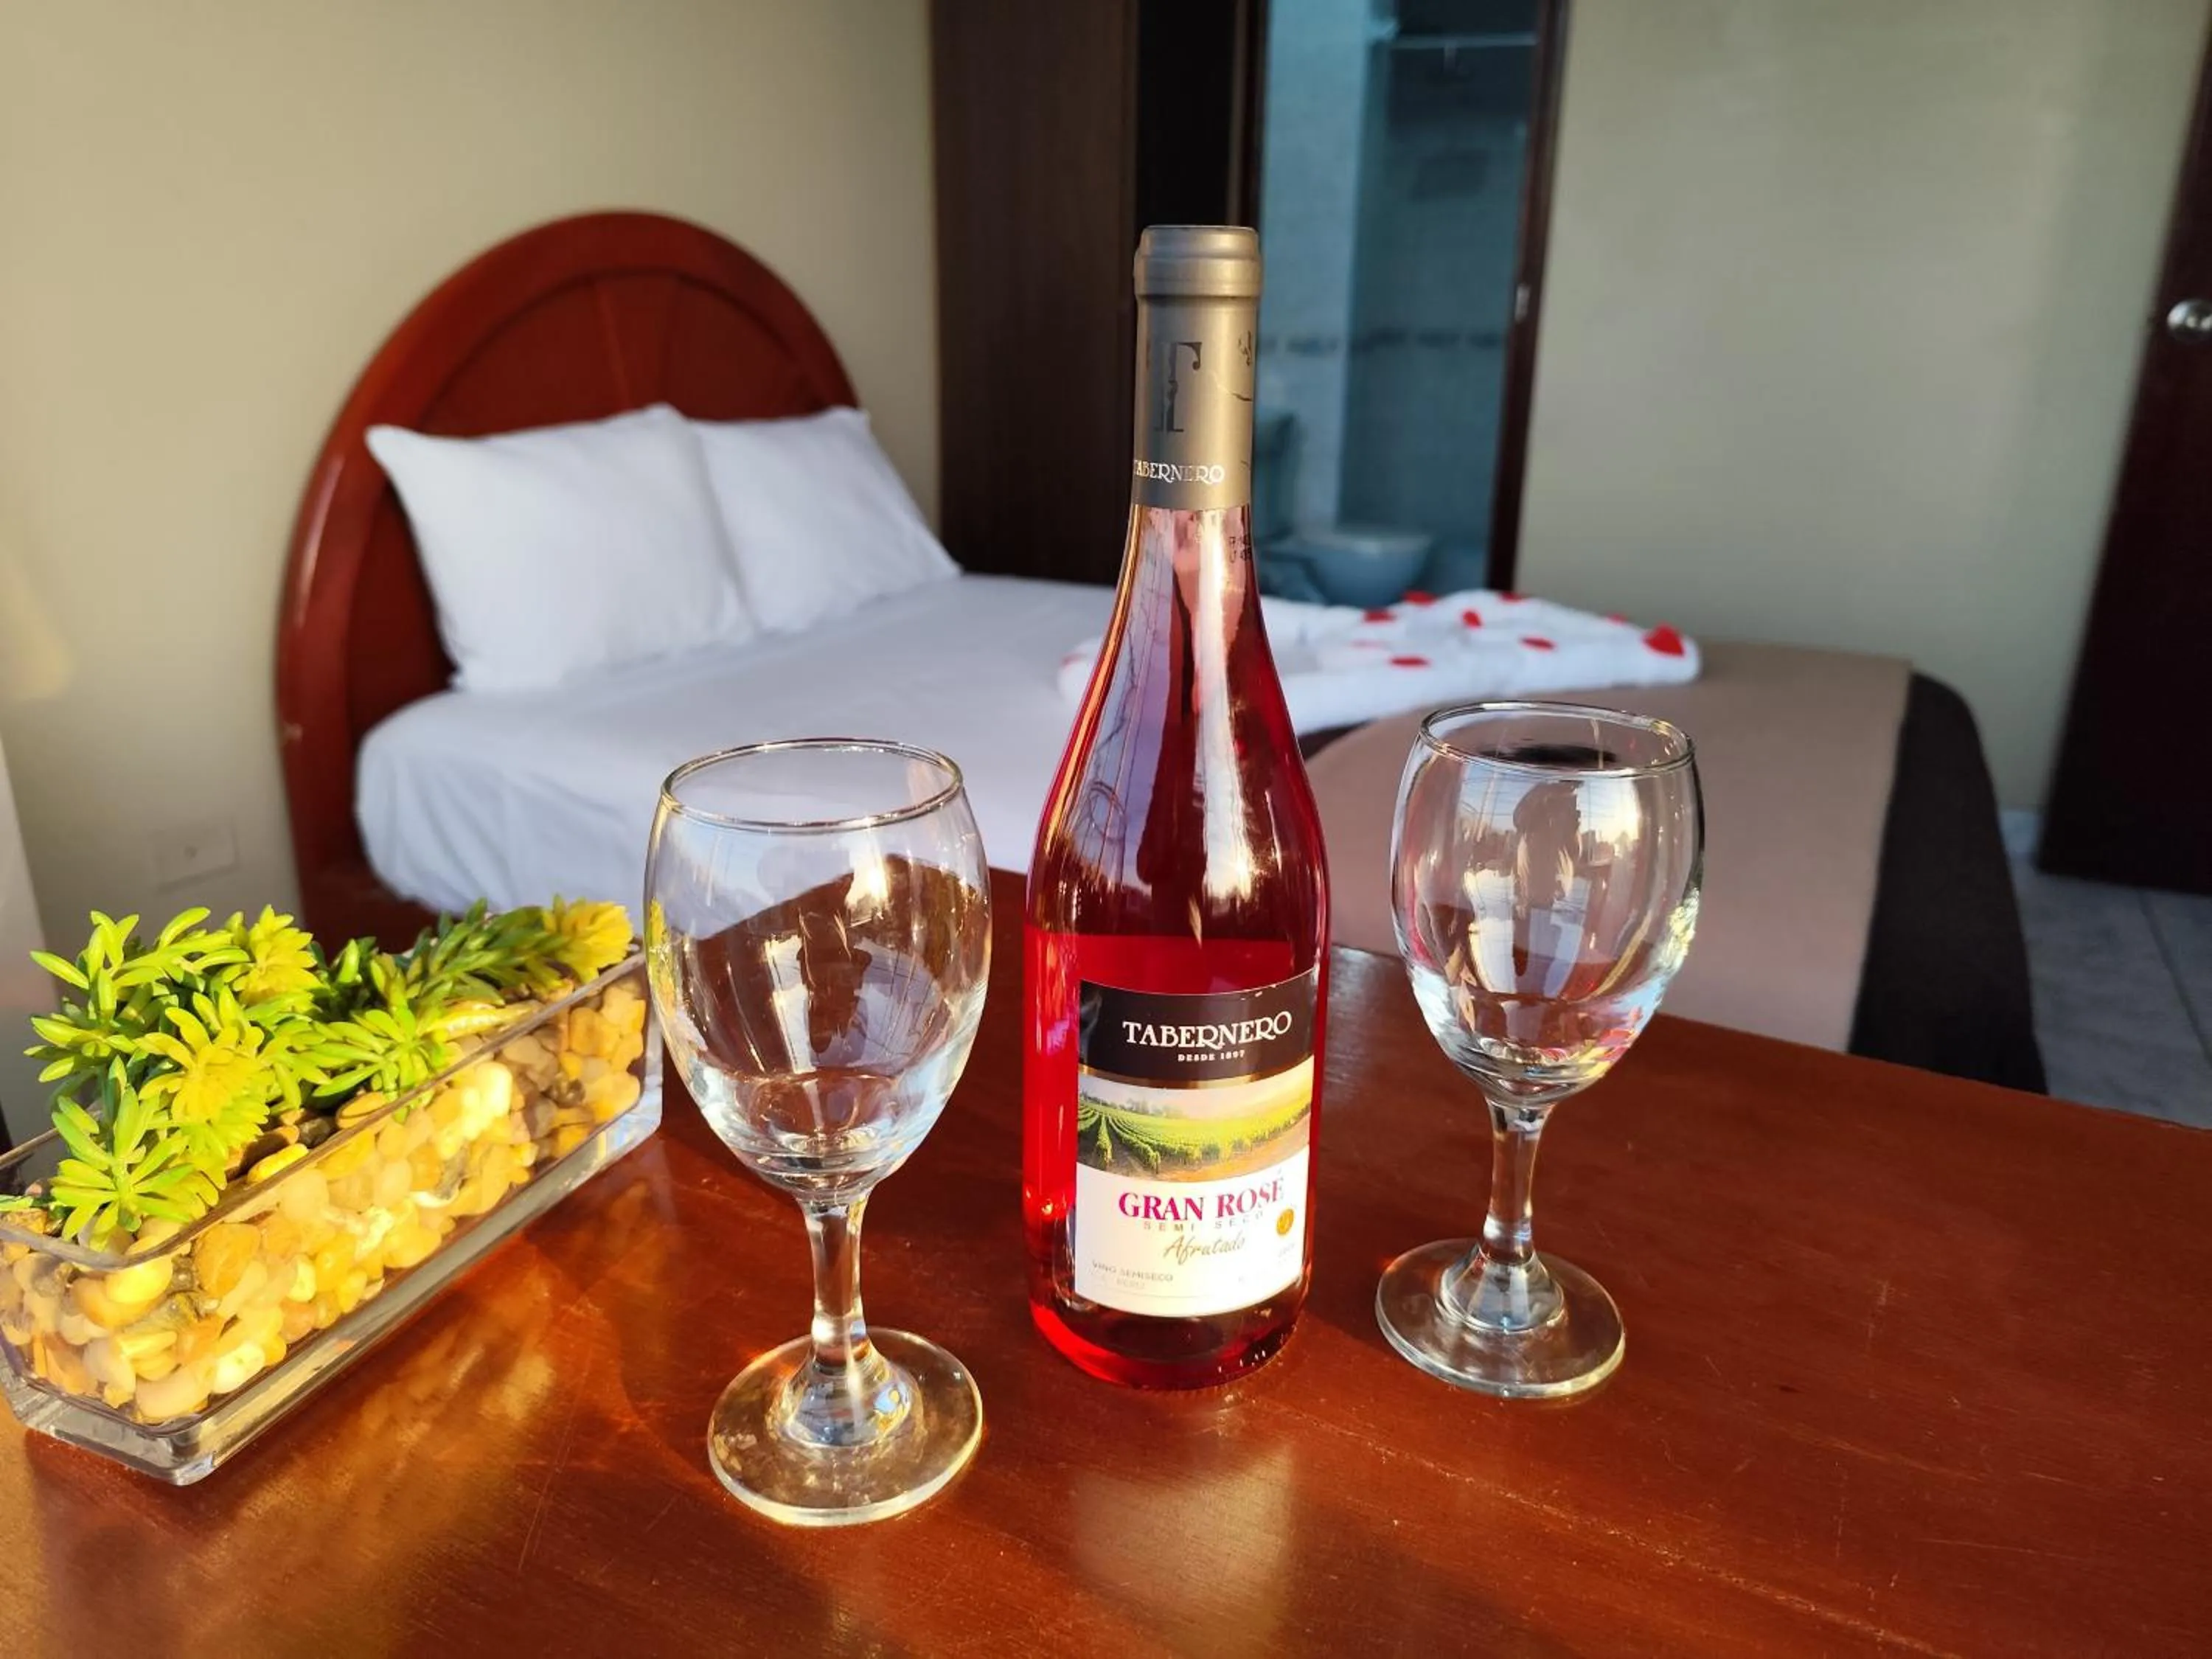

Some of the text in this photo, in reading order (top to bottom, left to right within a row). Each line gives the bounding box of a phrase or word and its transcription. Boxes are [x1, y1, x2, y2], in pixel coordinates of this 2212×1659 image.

[1122, 1011, 1292, 1050] TABERNERO
[1178, 1049, 1245, 1062] DESDE 1897
[1118, 1191, 1204, 1221] GRAN
[1144, 1220, 1194, 1232] SEMI
